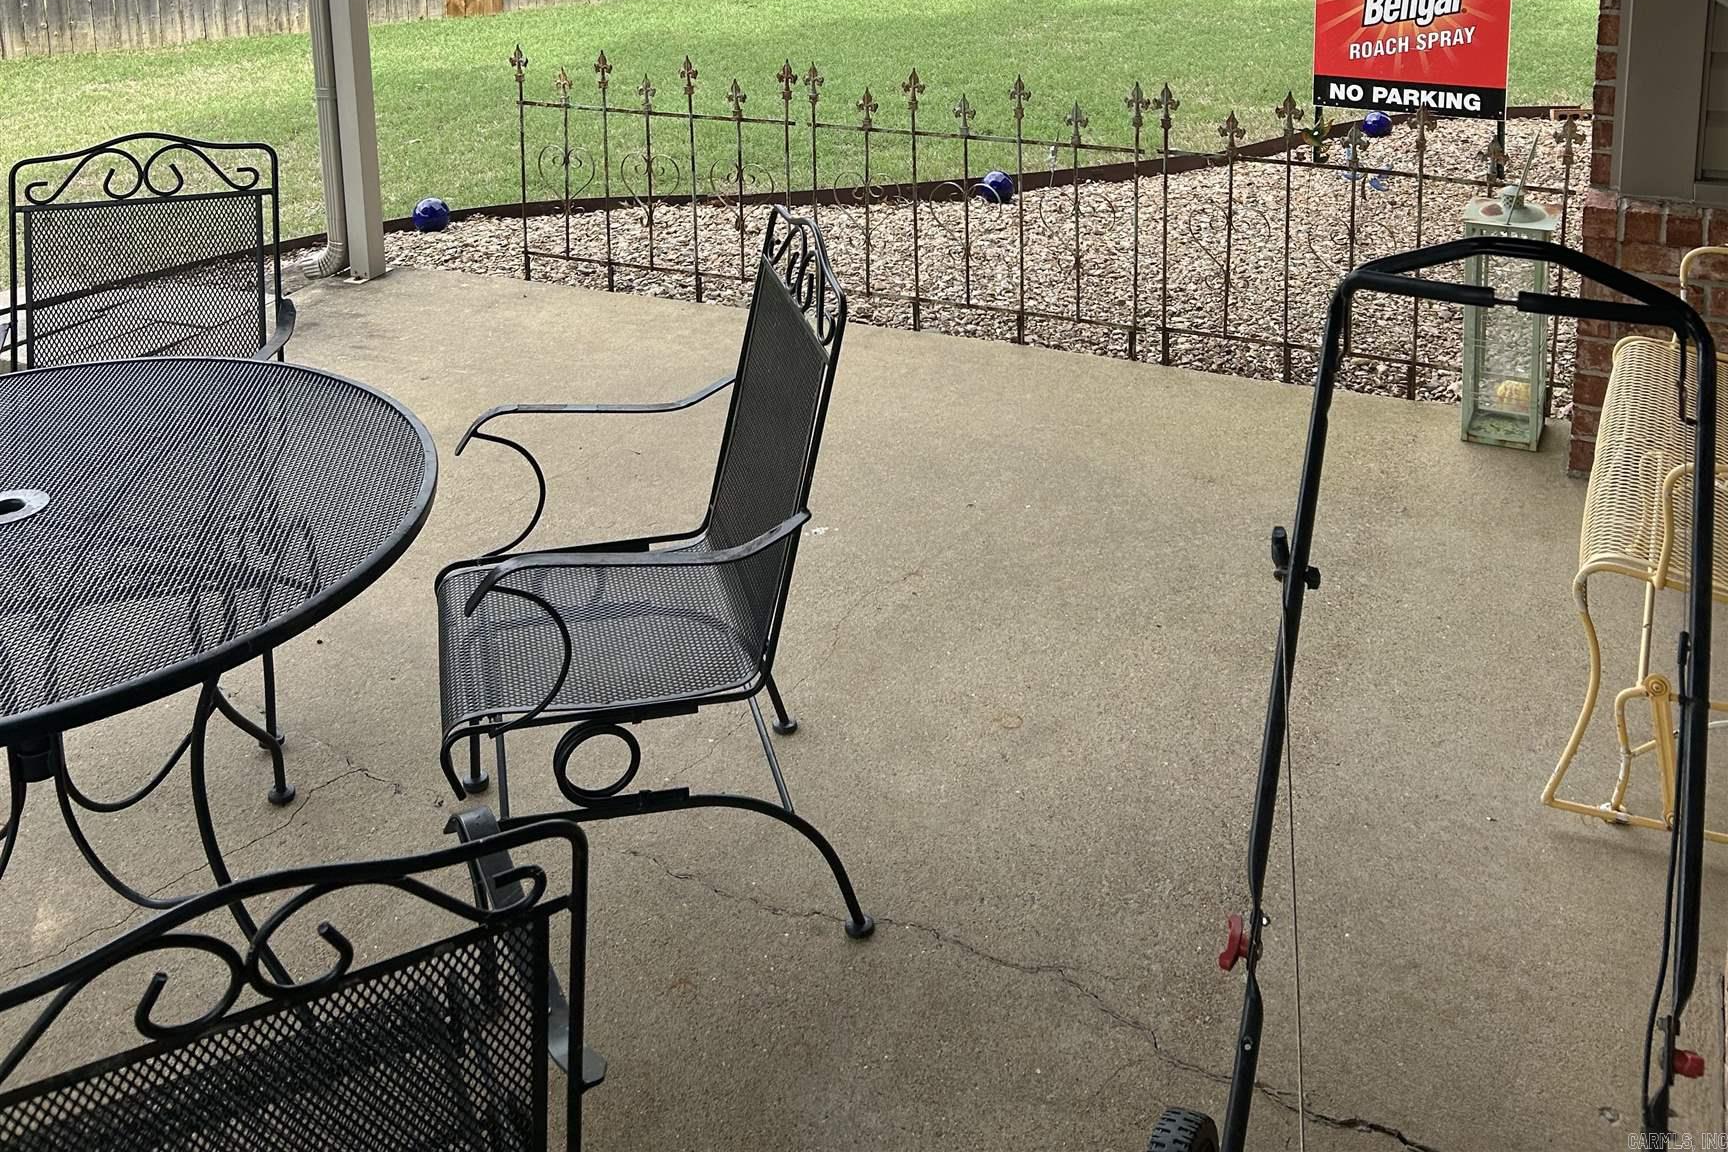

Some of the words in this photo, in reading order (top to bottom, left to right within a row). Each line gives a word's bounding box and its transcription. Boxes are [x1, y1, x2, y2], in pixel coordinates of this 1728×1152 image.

[1349, 36, 1409, 60] ROACH
[1415, 26, 1476, 51] SPRAY
[1329, 82, 1364, 102] NO
[1372, 86, 1481, 111] PARKING
